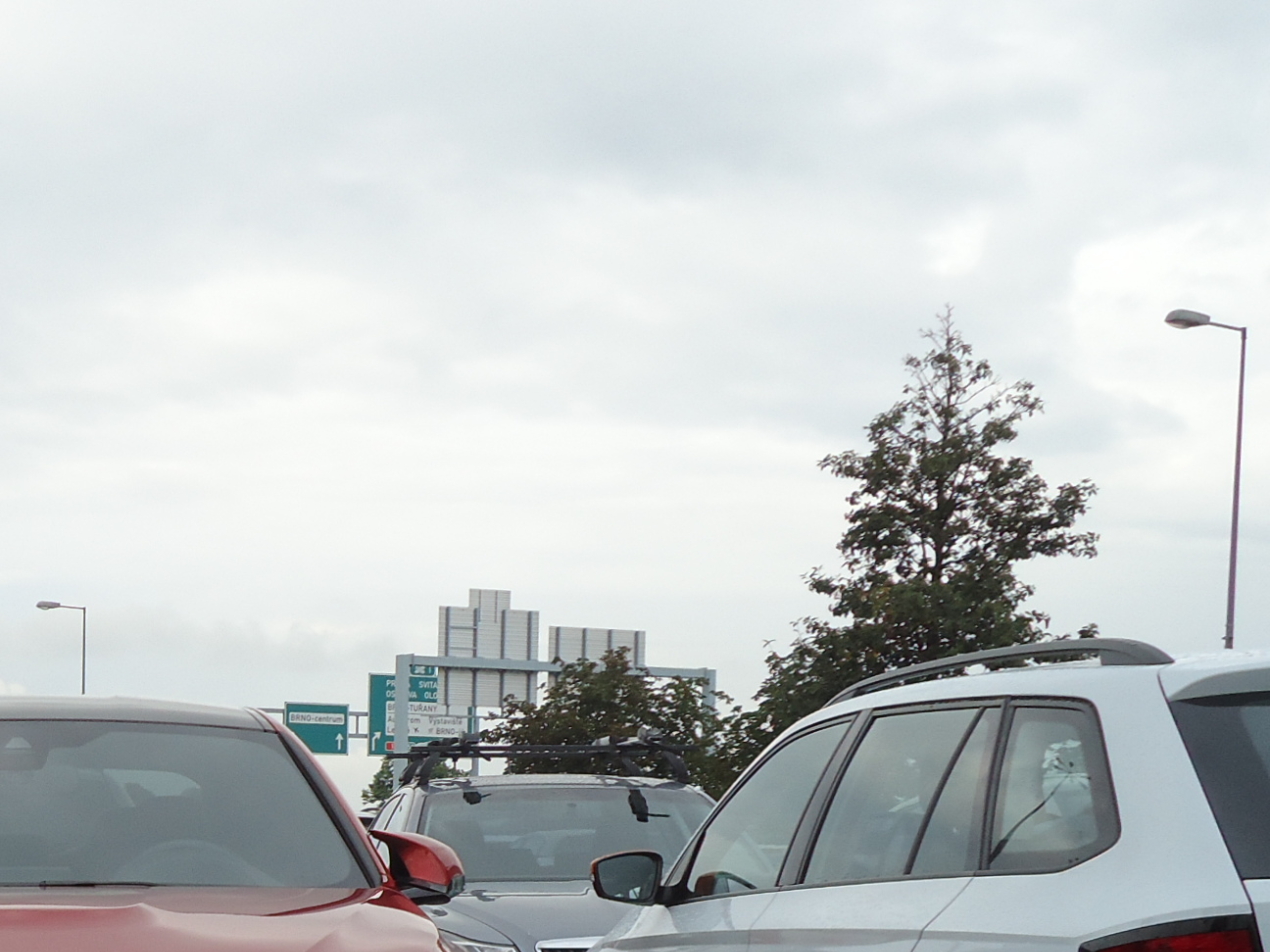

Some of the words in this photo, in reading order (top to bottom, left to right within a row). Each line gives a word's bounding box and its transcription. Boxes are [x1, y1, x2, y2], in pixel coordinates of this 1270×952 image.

[418, 680, 437, 688] SVITA
[386, 690, 418, 699] OSVA
[387, 703, 437, 712] B-TUŘANY
[290, 714, 343, 723] BRNO-centrum
[436, 727, 463, 735] BRNO-
